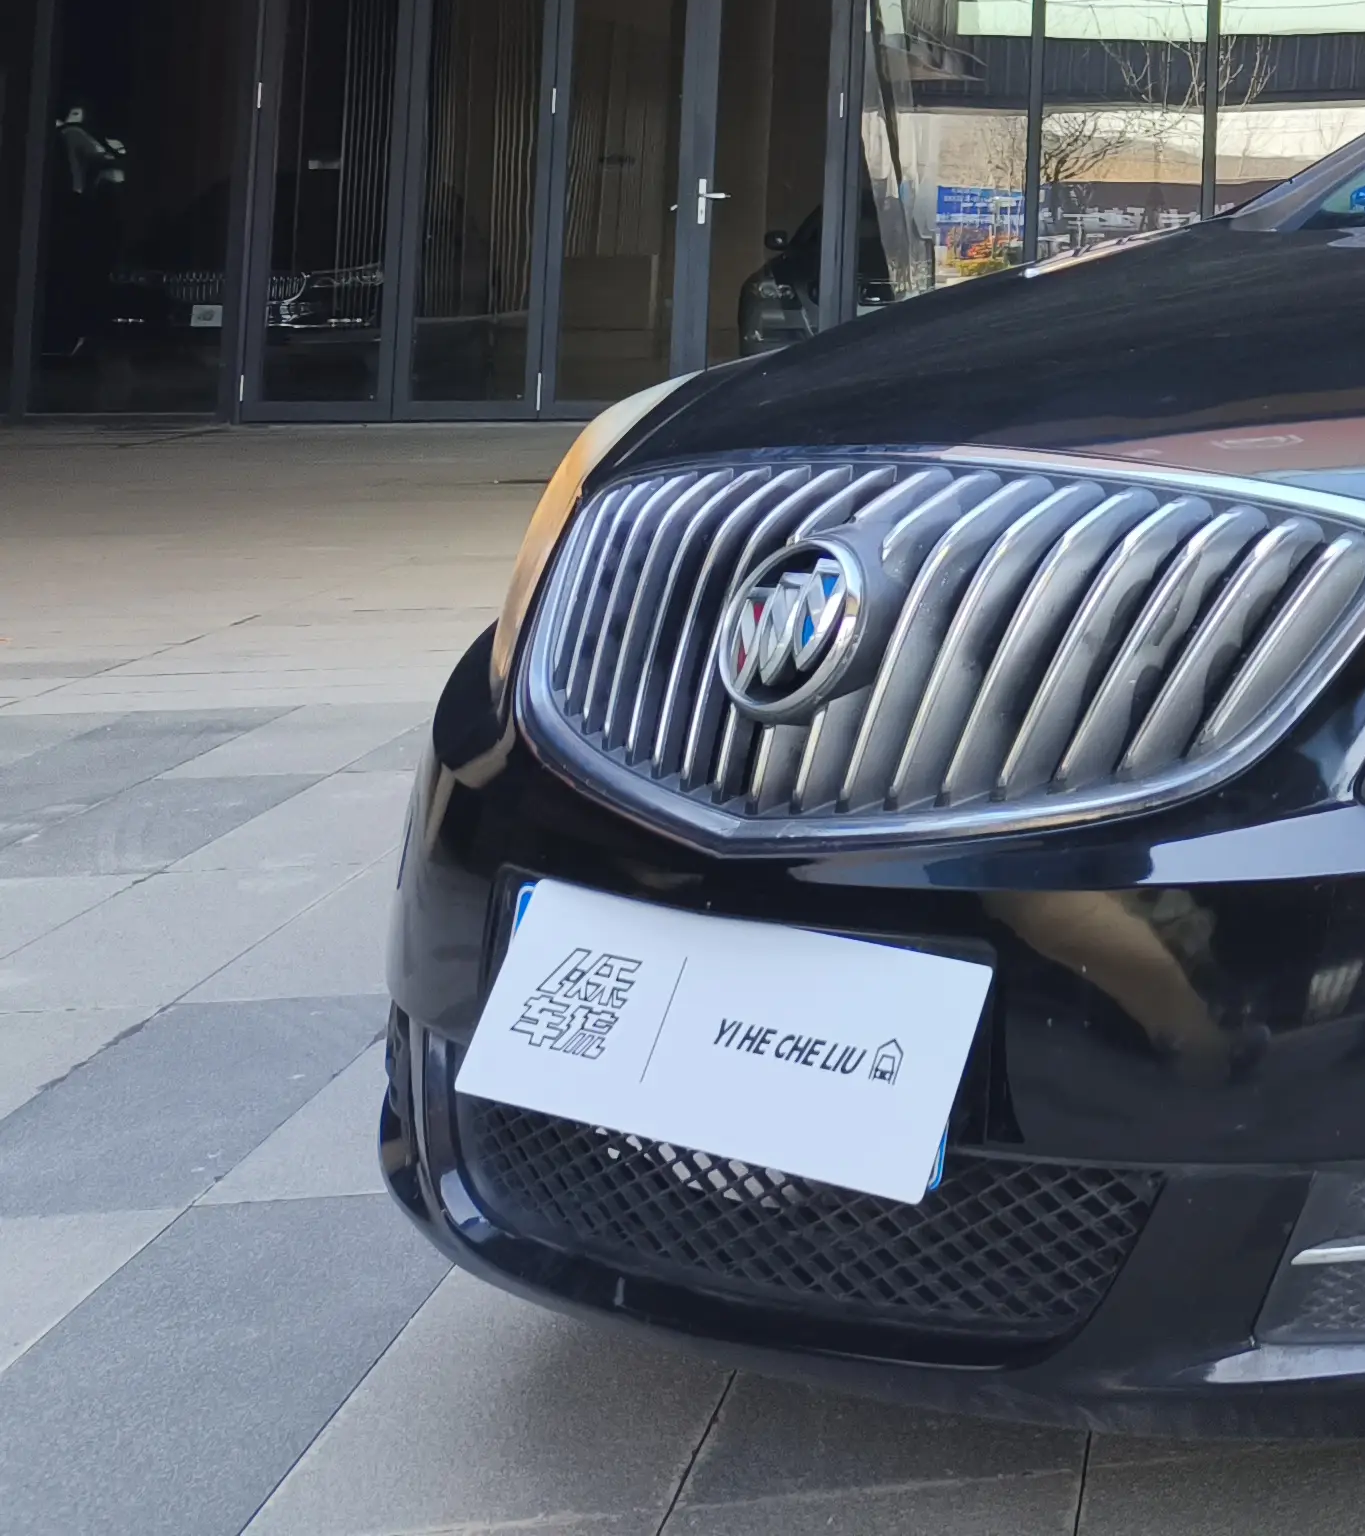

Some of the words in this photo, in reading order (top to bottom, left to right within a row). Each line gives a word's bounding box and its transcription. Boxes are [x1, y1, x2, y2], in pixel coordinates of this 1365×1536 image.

[713, 1018, 742, 1047] YI
[736, 1024, 778, 1056] HE
[773, 1034, 827, 1067] CHE
[819, 1043, 867, 1075] LIU
